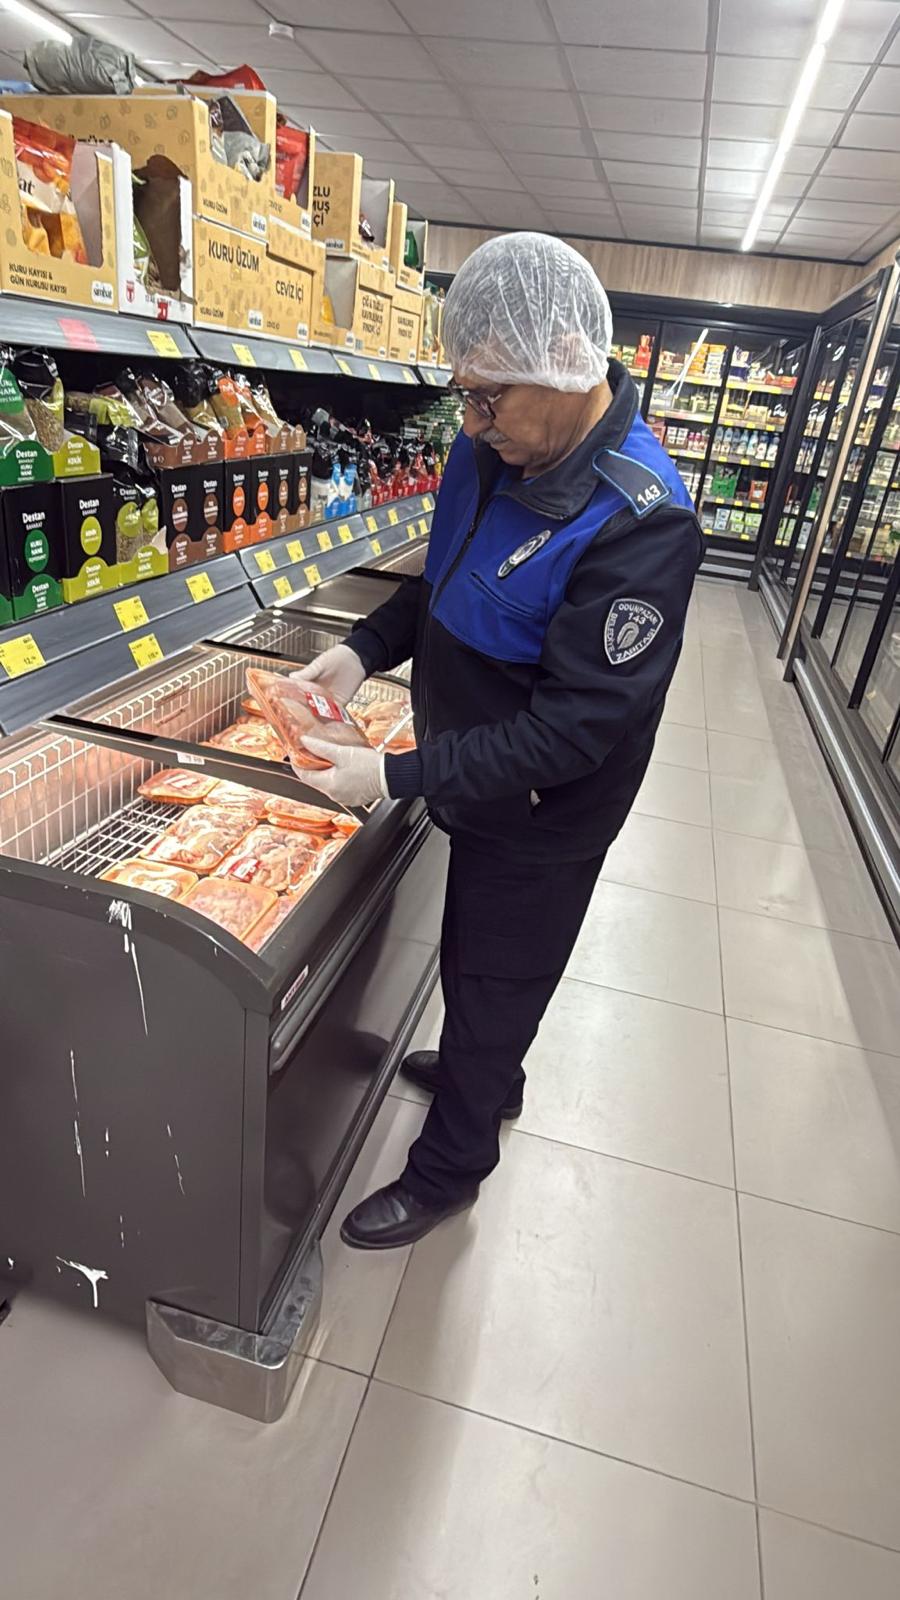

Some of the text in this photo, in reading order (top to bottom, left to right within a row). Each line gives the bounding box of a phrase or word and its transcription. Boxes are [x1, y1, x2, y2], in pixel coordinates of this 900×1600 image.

[208, 239, 260, 272] KURU ÜZÜM
[9, 263, 28, 276] KURU
[28, 266, 48, 279] KAYISI
[10, 273, 68, 295] GÜN KURUSU KAYISI
[275, 280, 295, 300] CEVİZ
[15, 449, 38, 459] Destan
[171, 484, 187, 493] Destan
[636, 484, 661, 506] 143
[79, 499, 100, 511] Destan
[22, 511, 46, 524] Destan
[31, 582, 49, 594] Destan
[618, 603, 659, 625] ODUNPAZARI
[628, 611, 647, 625] 143
[615, 628, 657, 661] ZABITASI
